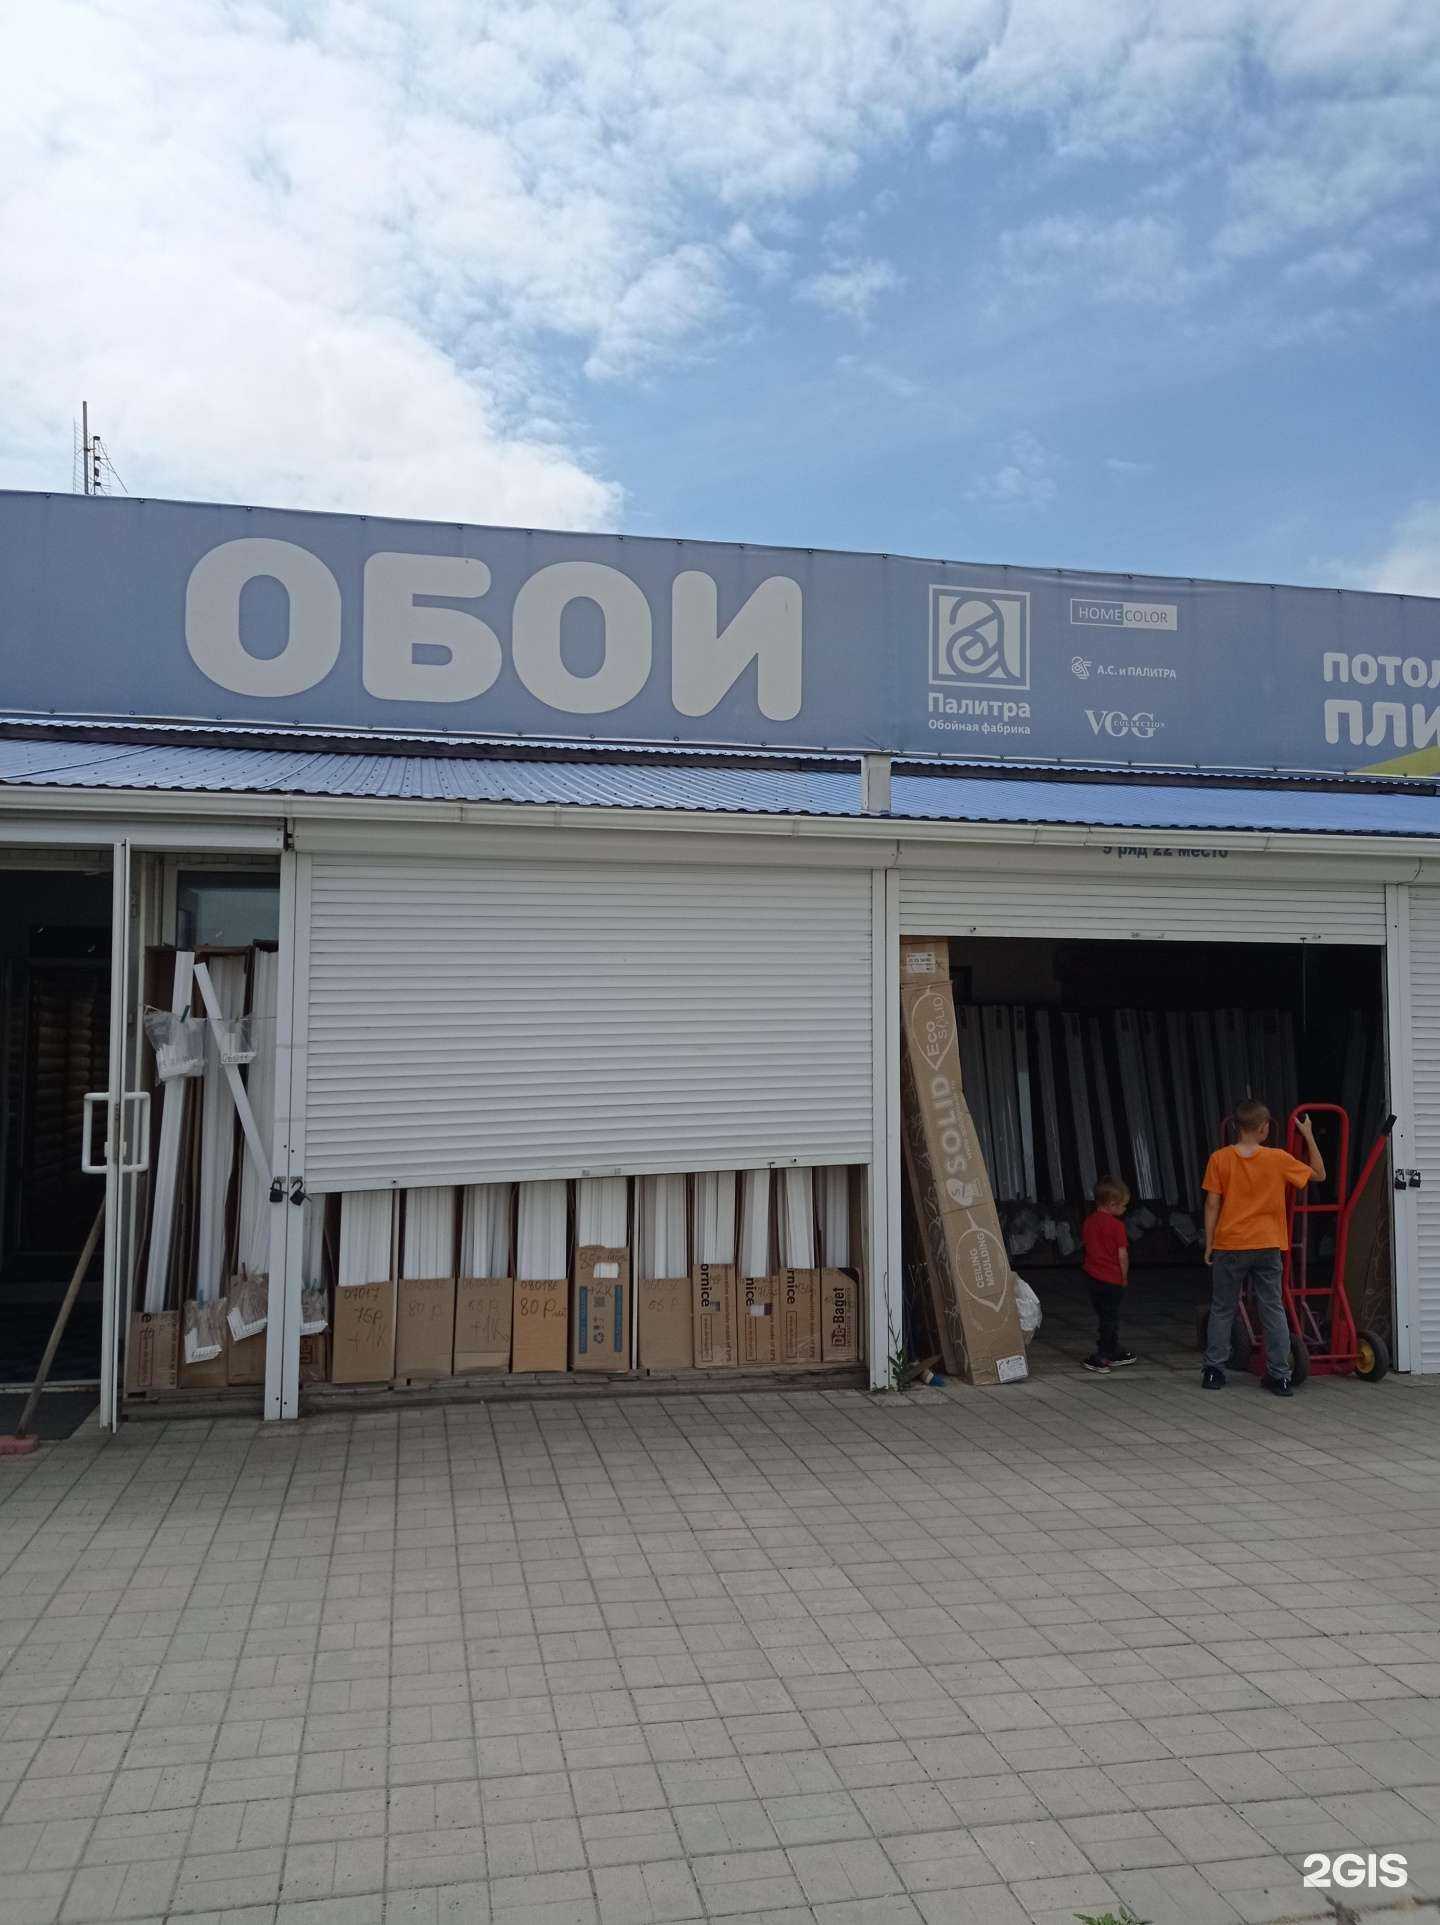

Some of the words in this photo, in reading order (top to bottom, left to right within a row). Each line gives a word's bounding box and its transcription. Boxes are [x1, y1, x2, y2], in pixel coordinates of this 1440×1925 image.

[184, 537, 804, 722] ОБОИ
[1079, 606, 1168, 624] HOMECOLOR
[1097, 665, 1117, 676] А.С.
[1119, 668, 1126, 676] и
[1127, 666, 1177, 680] ПАЛИТРА
[928, 692, 1031, 722] Палитра
[928, 719, 979, 732] Обойная
[981, 721, 1031, 735] фабрика
[1324, 699, 1440, 749] ПЛИ
[1178, 847, 1229, 858] место
[932, 1076, 967, 1173] SOLID
[976, 1231, 996, 1287] MOULDING
